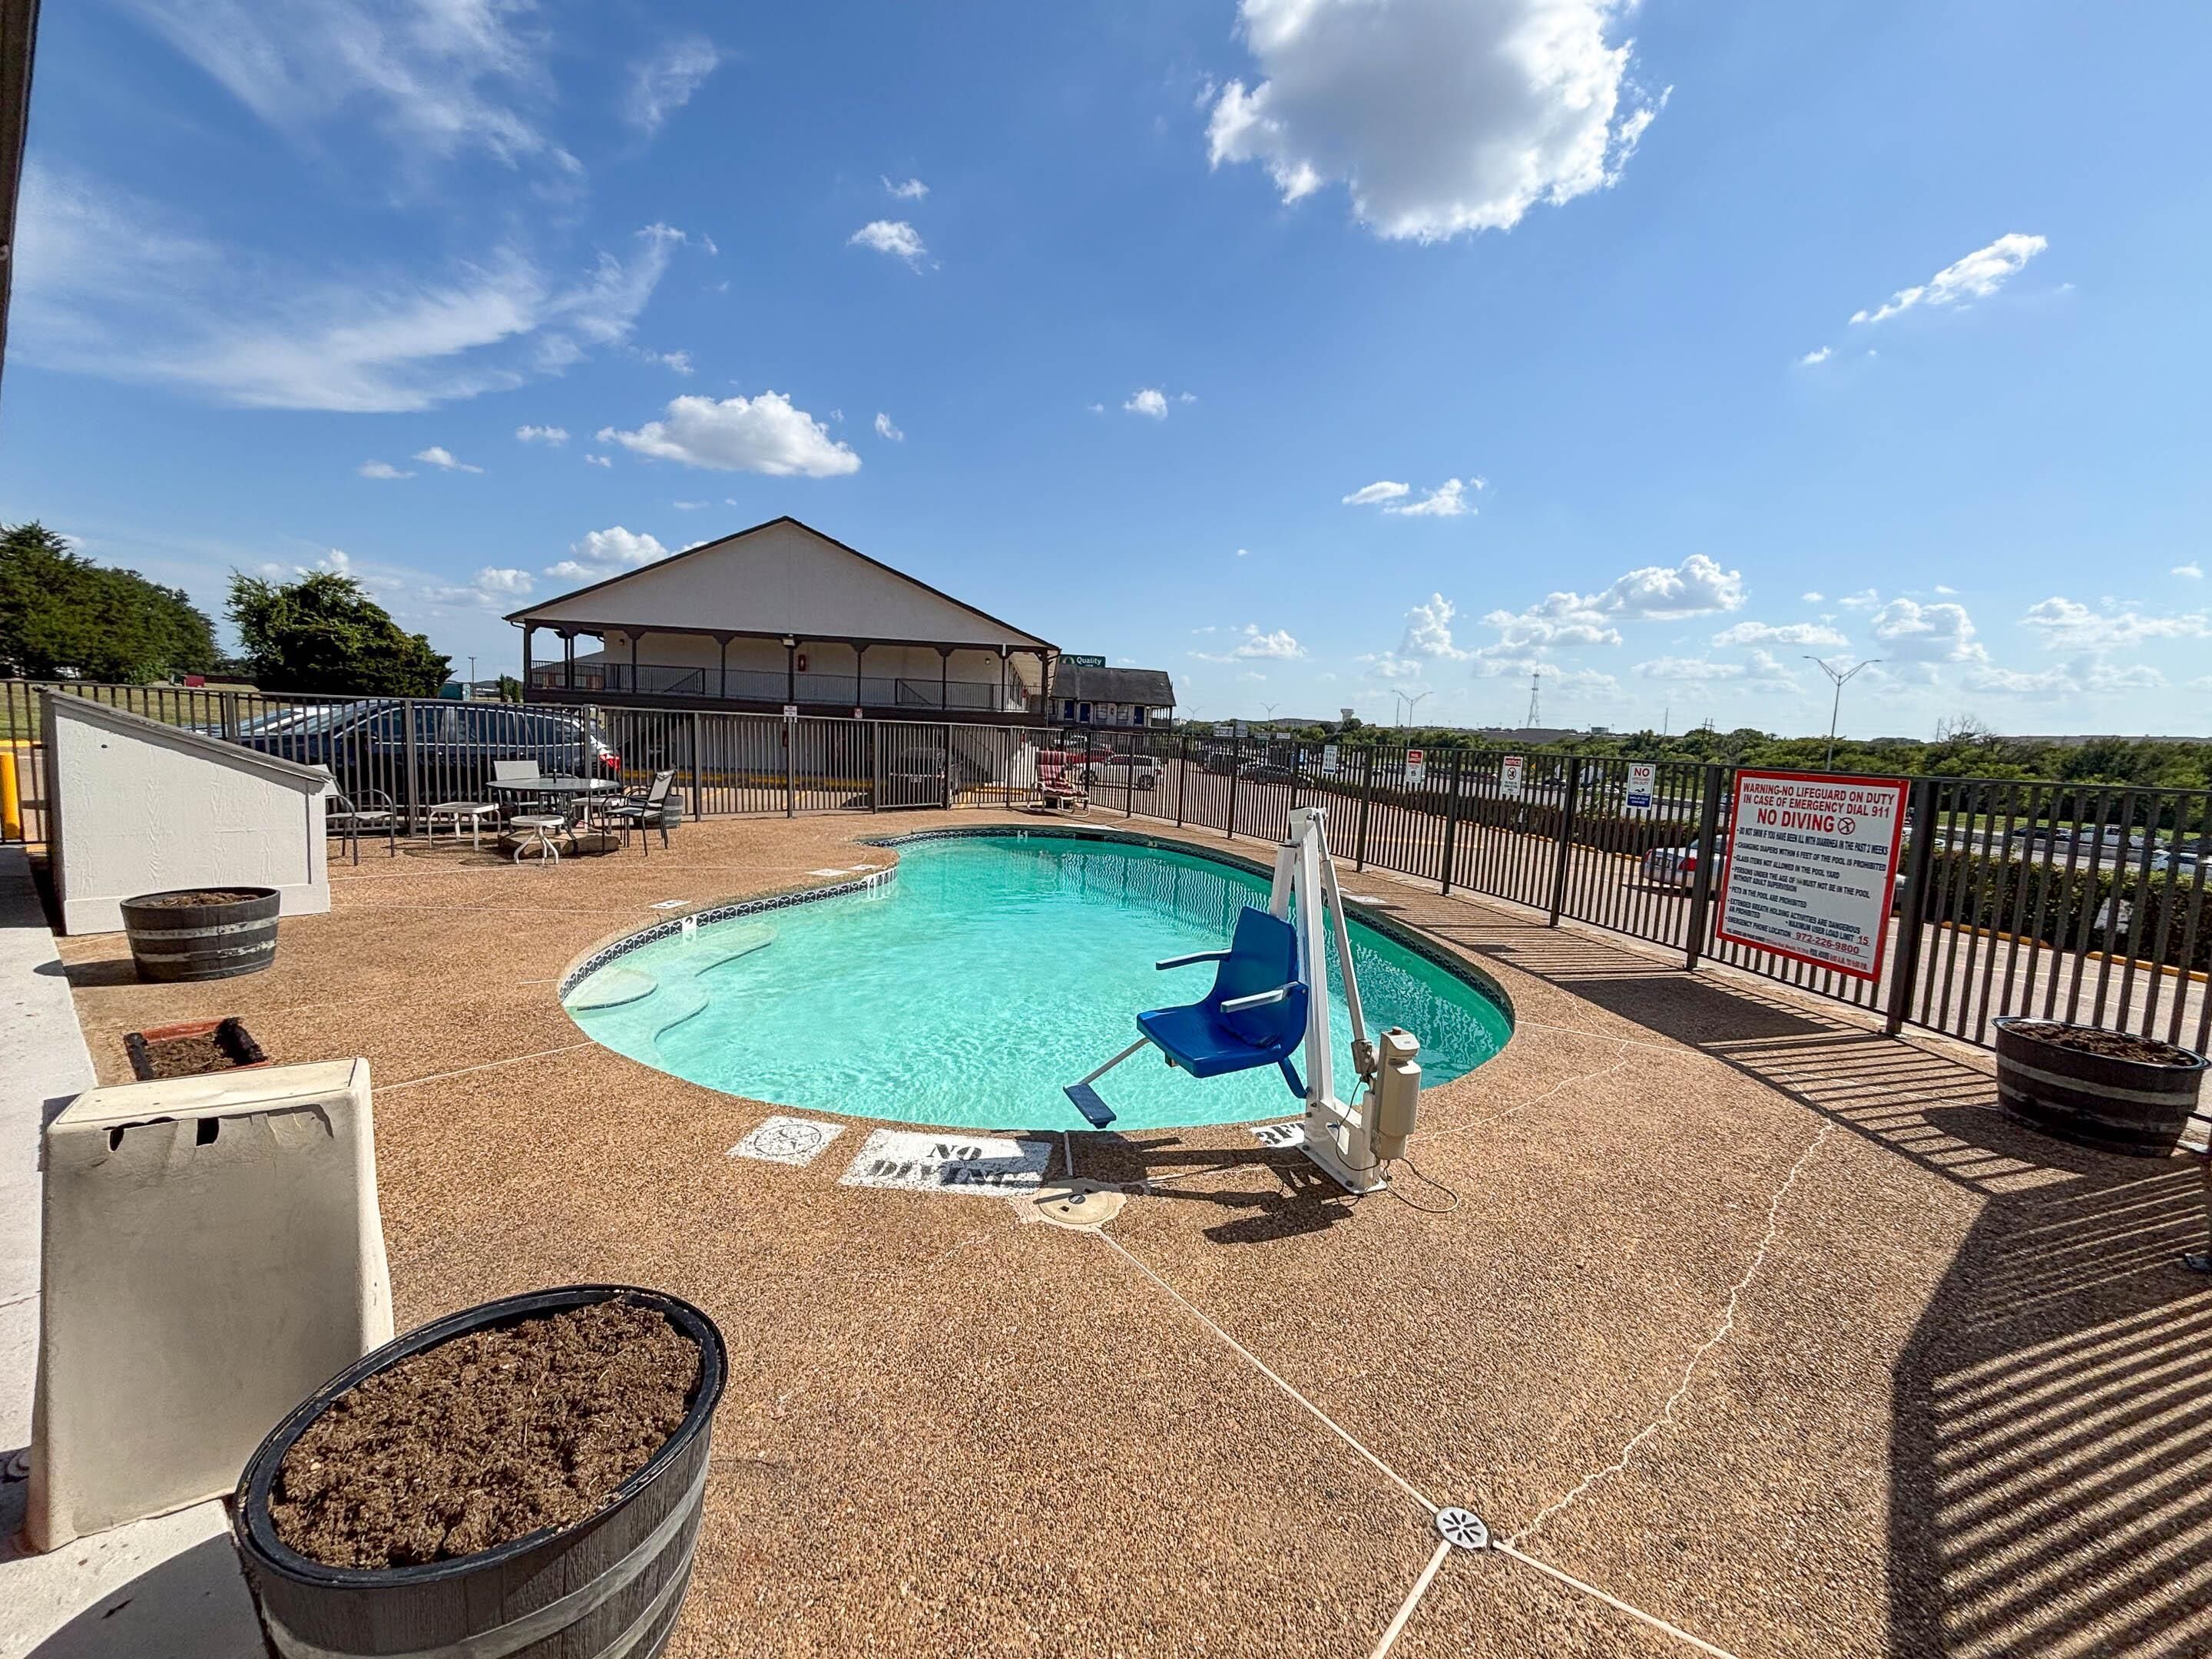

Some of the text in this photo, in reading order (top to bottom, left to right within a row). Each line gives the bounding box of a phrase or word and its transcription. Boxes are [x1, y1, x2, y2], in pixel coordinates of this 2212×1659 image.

[1076, 657, 1102, 665] Quality
[1634, 767, 1650, 777] NO
[1743, 783, 1895, 805] WARNING-NO LIFEGUARD ON DUTY
[1743, 794, 1889, 817] IN CASE OF EMERGENCY DIAL 911
[1757, 808, 1835, 833] NO DIVING
[1776, 832, 1786, 841] HAVE
[1787, 833, 1797, 843] BEEN
[1806, 836, 1816, 845] WITH
[1839, 840, 1844, 849] IN
[1845, 841, 1854, 850] THE
[1855, 843, 1866, 852] PAST
[1867, 844, 1870, 853] 2
[1871, 845, 1889, 855] WEEKS
[1738, 843, 1759, 851] CHANGING
[1760, 846, 1778, 854] DIAPERS
[1832, 856, 1846, 865] POOL
[1853, 859, 1886, 871] PROHIBITED
[1773, 861, 1794, 870] ALLOWED
[1812, 868, 1826, 876] POOL
[1826, 870, 1839, 879] YARD
[1734, 866, 1753, 876] PERSONS
[1753, 870, 1768, 879] UNDER
[1803, 879, 1816, 888] MUST
[1817, 882, 1828, 890] NOT
[1855, 889, 1870, 898] POOL
[1734, 874, 1752, 883] WITHOUT
[1767, 881, 1796, 892] SUPERVISION
[1779, 896, 1807, 908] PROHIBITED
[1730, 899, 1751, 909] EXTENDED
[1752, 903, 1769, 912] BREATH
[1770, 908, 1790, 917] HOLDING
[1790, 912, 1817, 924] ACTIVITIES
[1829, 921, 1860, 934] DANGEROUS
[1736, 908, 1760, 919] PROHIBITED
[1728, 916, 1753, 928] EMERGENCY
[1753, 922, 1768, 932] PHONE
[1769, 927, 1791, 938] LOCATION
[1796, 932, 1859, 955] 972-226-9800
[1789, 920, 1869, 945] MAXIMUM USER LOAD LIMIT 15
[926, 1143, 982, 1161] NO
